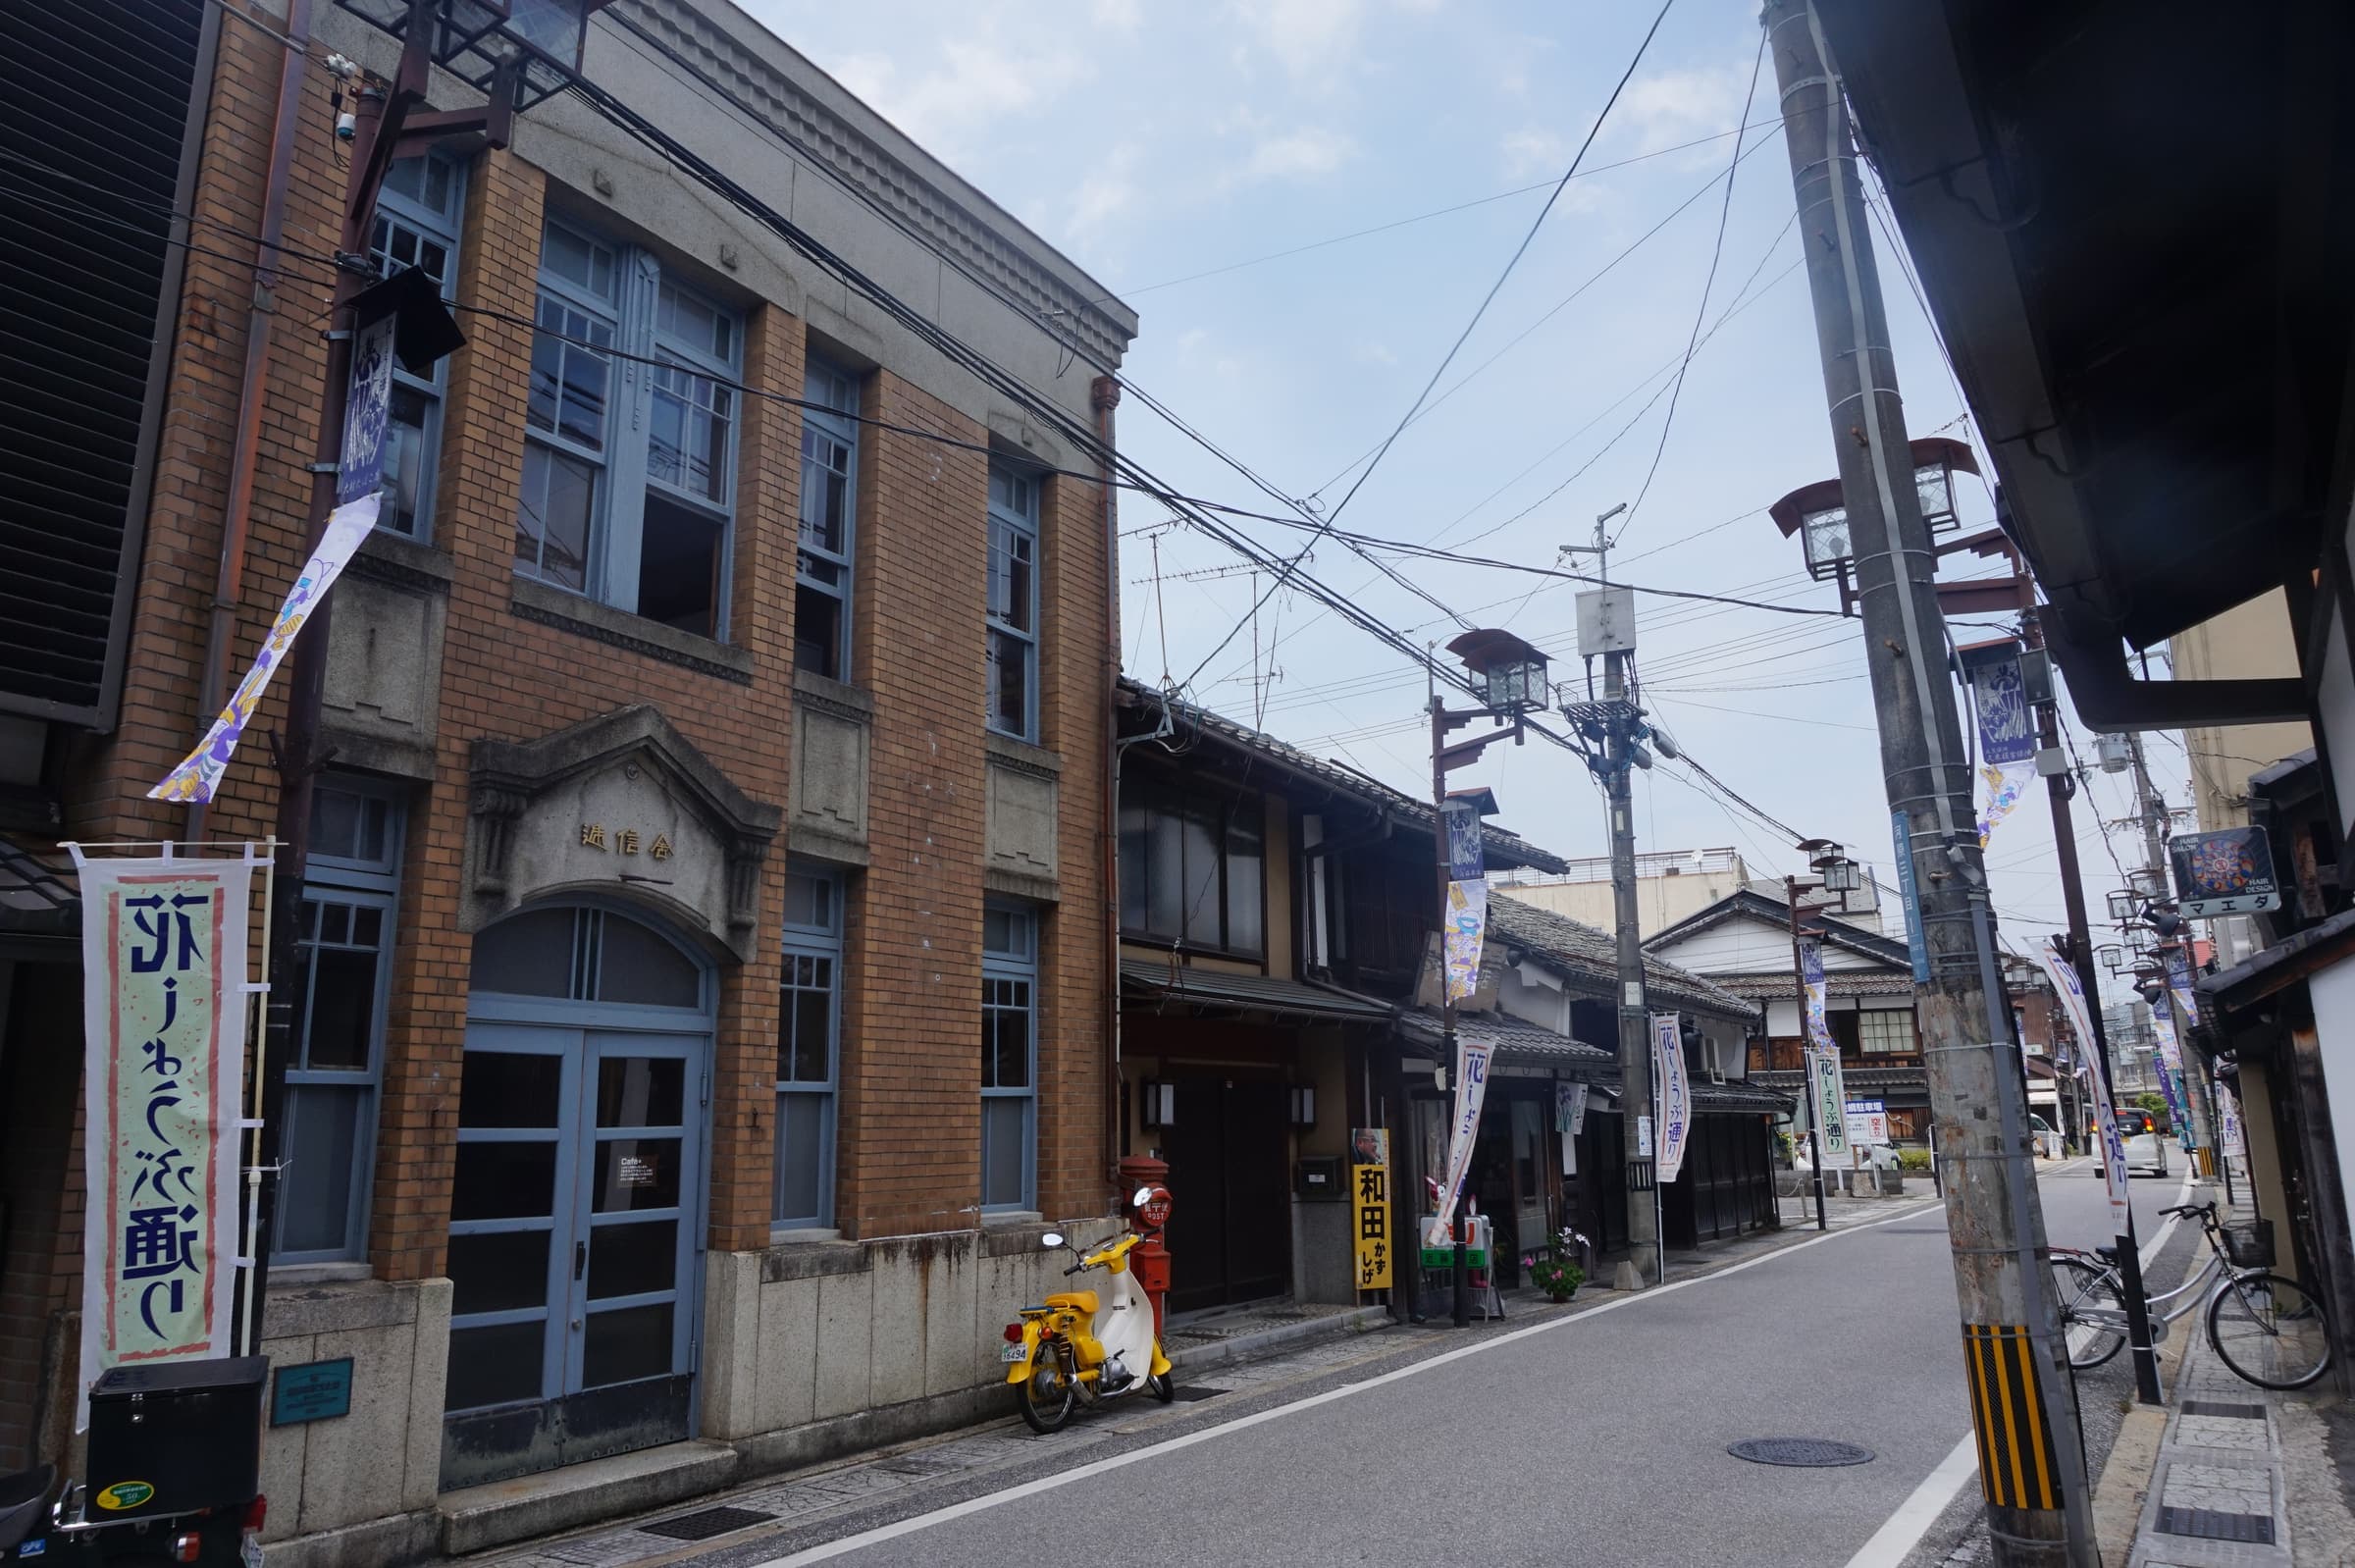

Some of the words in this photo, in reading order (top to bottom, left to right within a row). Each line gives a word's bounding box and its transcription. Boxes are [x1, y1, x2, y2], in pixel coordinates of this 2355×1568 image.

[2189, 895, 2269, 915] マエダ
[2245, 885, 2275, 894] DESIGN
[1660, 1026, 1683, 1160] 花しょうぶ通り
[1818, 1059, 1843, 1151] 花しょうぶ通り
[1360, 1169, 1386, 1240] 和田
[1362, 1251, 1374, 1284] しげ
[1375, 1242, 1386, 1275] かず
